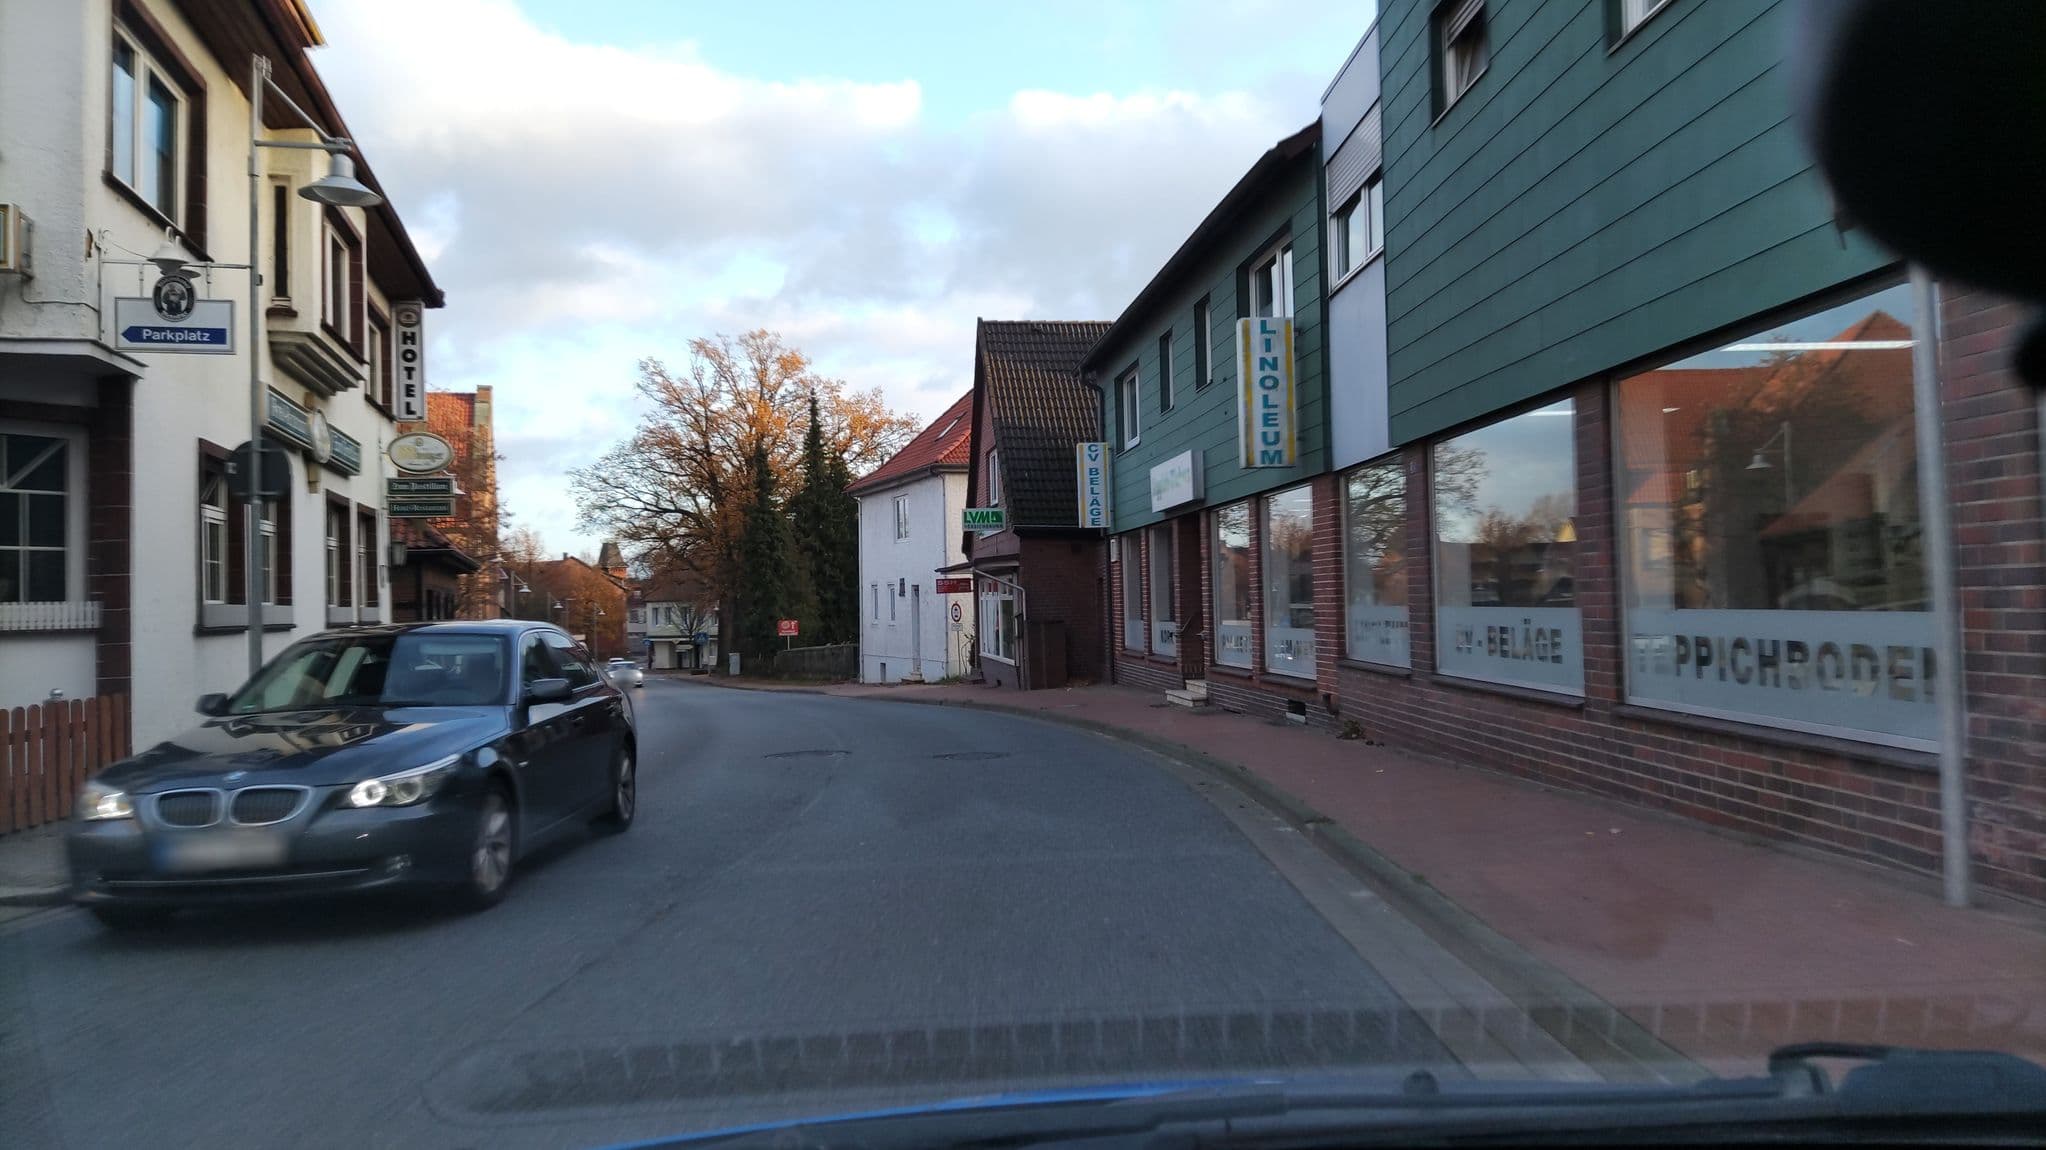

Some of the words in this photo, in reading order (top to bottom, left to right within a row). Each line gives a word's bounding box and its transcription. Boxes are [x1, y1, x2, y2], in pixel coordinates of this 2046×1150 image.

[142, 328, 211, 342] Parkplatz
[401, 331, 417, 415] HOTEL
[1258, 319, 1282, 465] LINOLEUM
[1088, 443, 1099, 462] CV
[1089, 467, 1101, 526] BELÄGE
[963, 511, 990, 523] LVM
